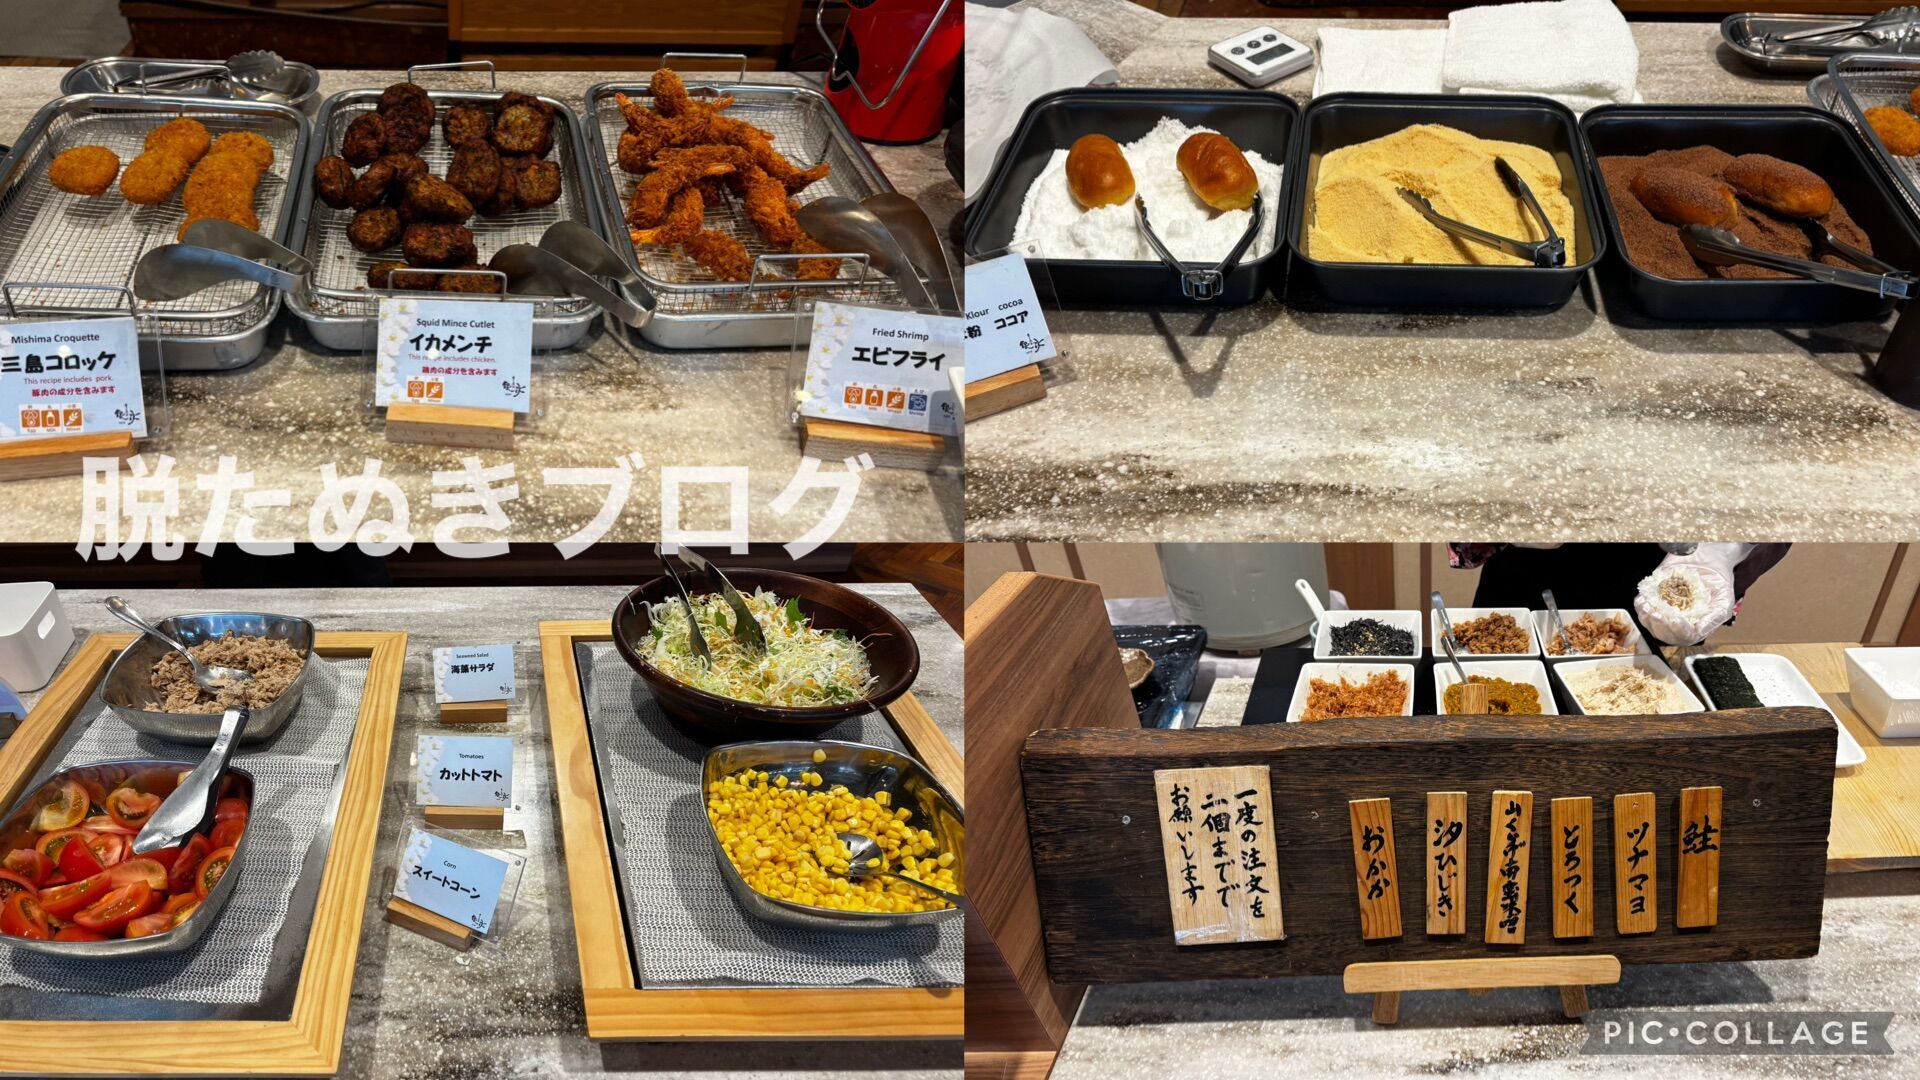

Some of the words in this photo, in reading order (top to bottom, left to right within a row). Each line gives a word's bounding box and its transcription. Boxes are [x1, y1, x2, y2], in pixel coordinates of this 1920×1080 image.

[998, 298, 1024, 311] cocoa
[416, 318, 440, 328] Squid
[441, 319, 468, 328] Mince
[469, 320, 496, 329] Cutlet
[964, 324, 983, 340] 粉
[993, 310, 1029, 330] ココア
[11, 334, 52, 345] Mishima
[53, 333, 101, 344] Croquette
[409, 333, 493, 353] イカメンチ
[872, 327, 896, 338] Fried
[897, 330, 930, 343] Shrimp
[1, 350, 117, 374] 三島コロッケ
[408, 353, 421, 361] This
[443, 355, 470, 363] includes
[851, 346, 946, 372] エビフライ
[40, 377, 62, 386] recipe
[63, 375, 93, 384] includes
[31, 386, 117, 398] 豚肉の成分を含みます
[451, 662, 495, 674] 海藻サラダ
[439, 767, 503, 782] カットトマト
[1168, 783, 1205, 906] お願いします
[1682, 814, 1719, 855] 鮭
[1234, 788, 1270, 919] 一度の注文を
[1361, 825, 1391, 900] おかか
[443, 860, 457, 870] Corn
[1433, 819, 1463, 918] 汐ひじき
[1626, 821, 1650, 915] ツナマヨ
[412, 865, 481, 899] スイートコーン
